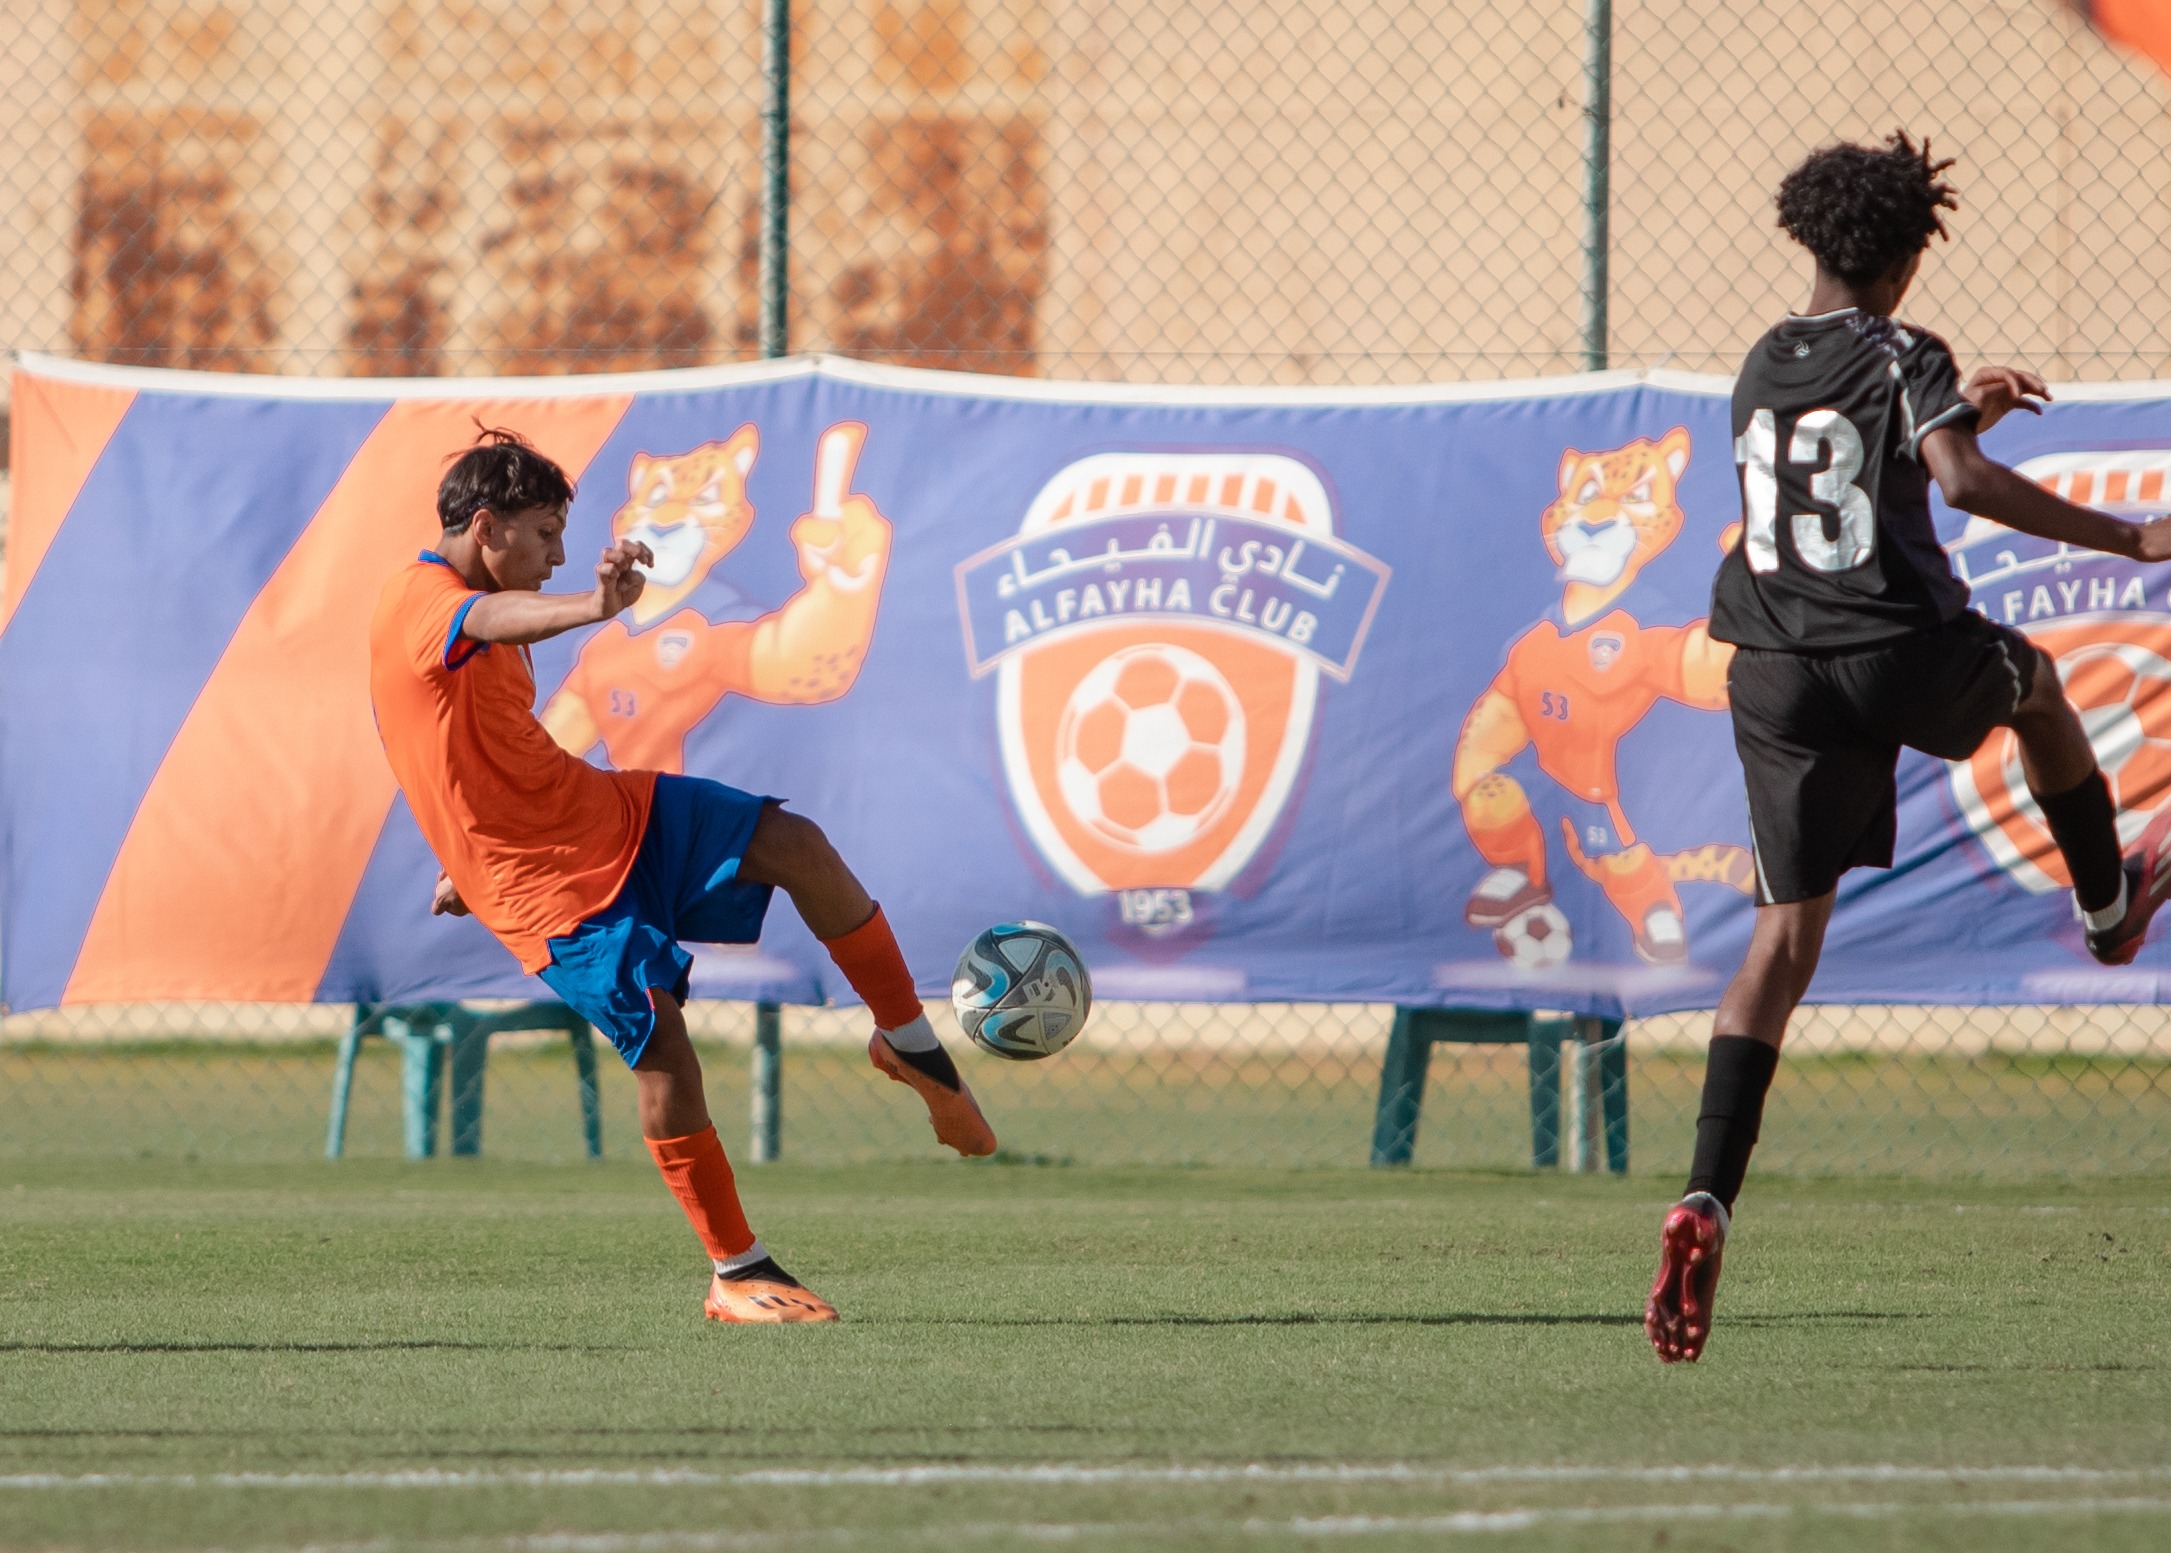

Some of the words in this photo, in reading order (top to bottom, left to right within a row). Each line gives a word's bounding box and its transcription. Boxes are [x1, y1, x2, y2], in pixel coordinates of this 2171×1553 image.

[1734, 408, 1874, 574] 13
[996, 517, 1217, 600] الفيحاء
[1218, 539, 1346, 600] نادي
[1003, 576, 1192, 643] ALFAYHA
[1209, 583, 1319, 645] CLUB
[1541, 691, 1569, 721] 53
[1120, 889, 1194, 925] 1953
